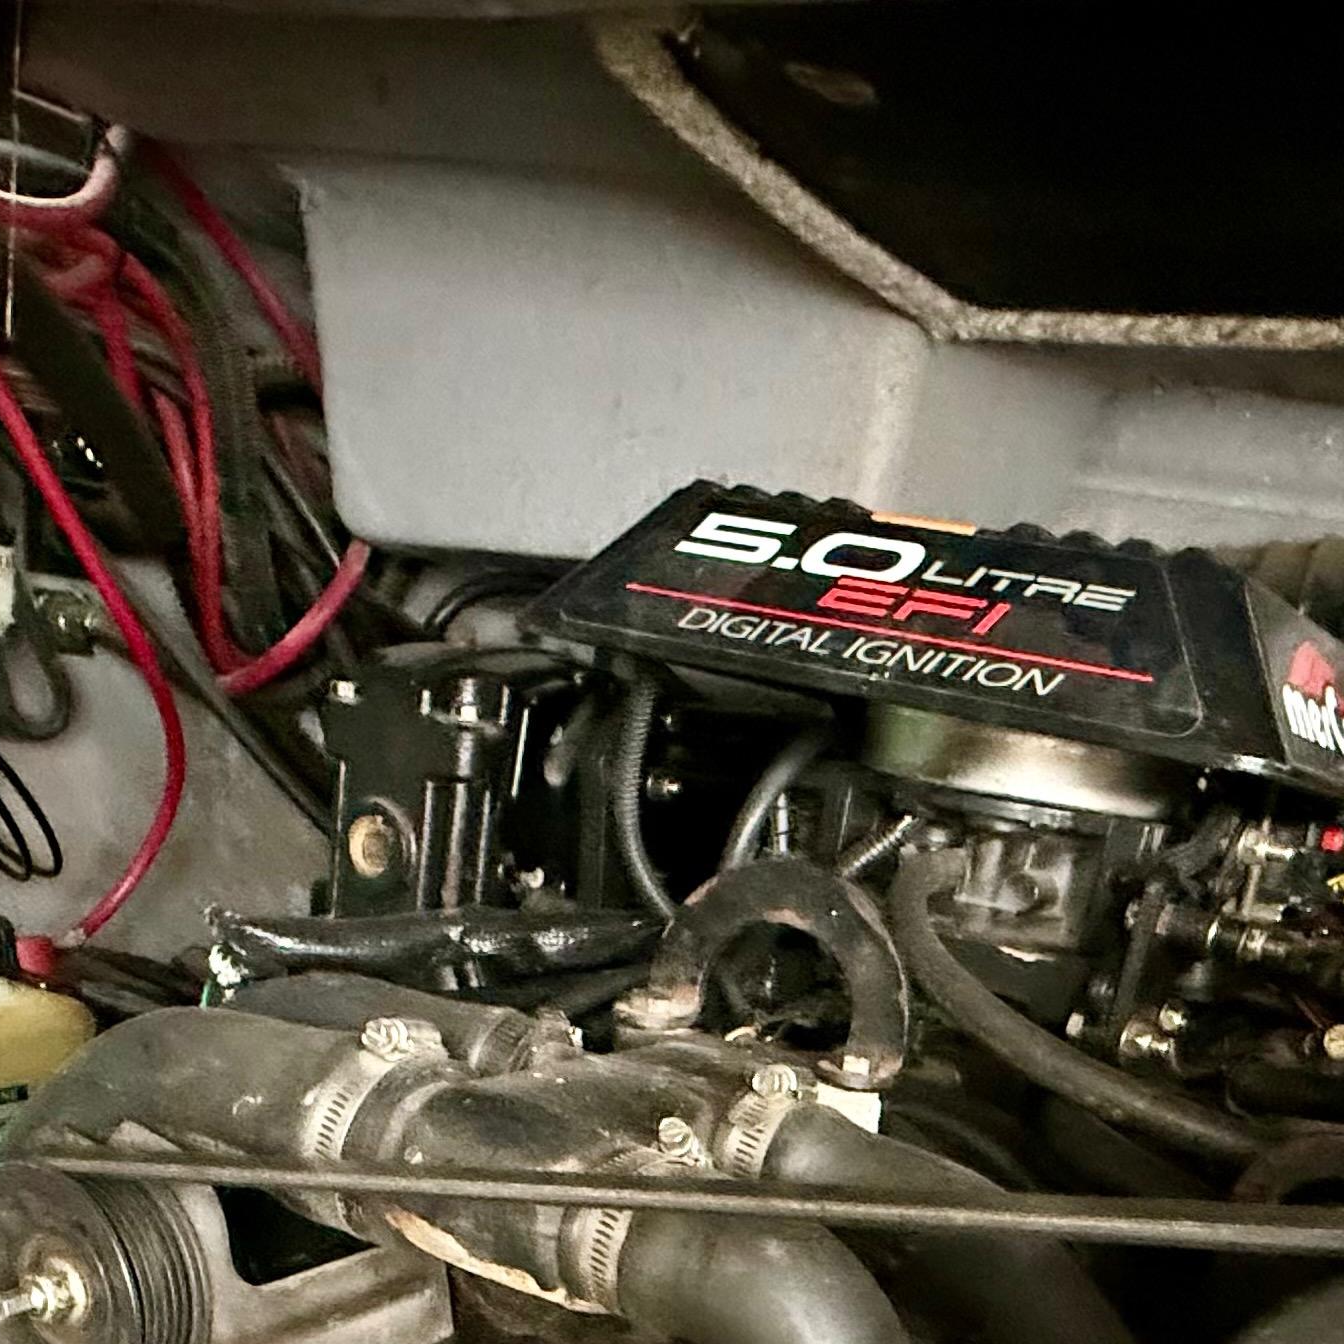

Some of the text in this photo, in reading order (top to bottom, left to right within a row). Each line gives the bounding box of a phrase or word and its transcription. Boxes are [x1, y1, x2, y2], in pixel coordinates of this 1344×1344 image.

[673, 511, 1137, 612] 5.0 LITRE
[816, 575, 1012, 636] EFI
[677, 607, 1065, 697] DIGITAL IGNITION
